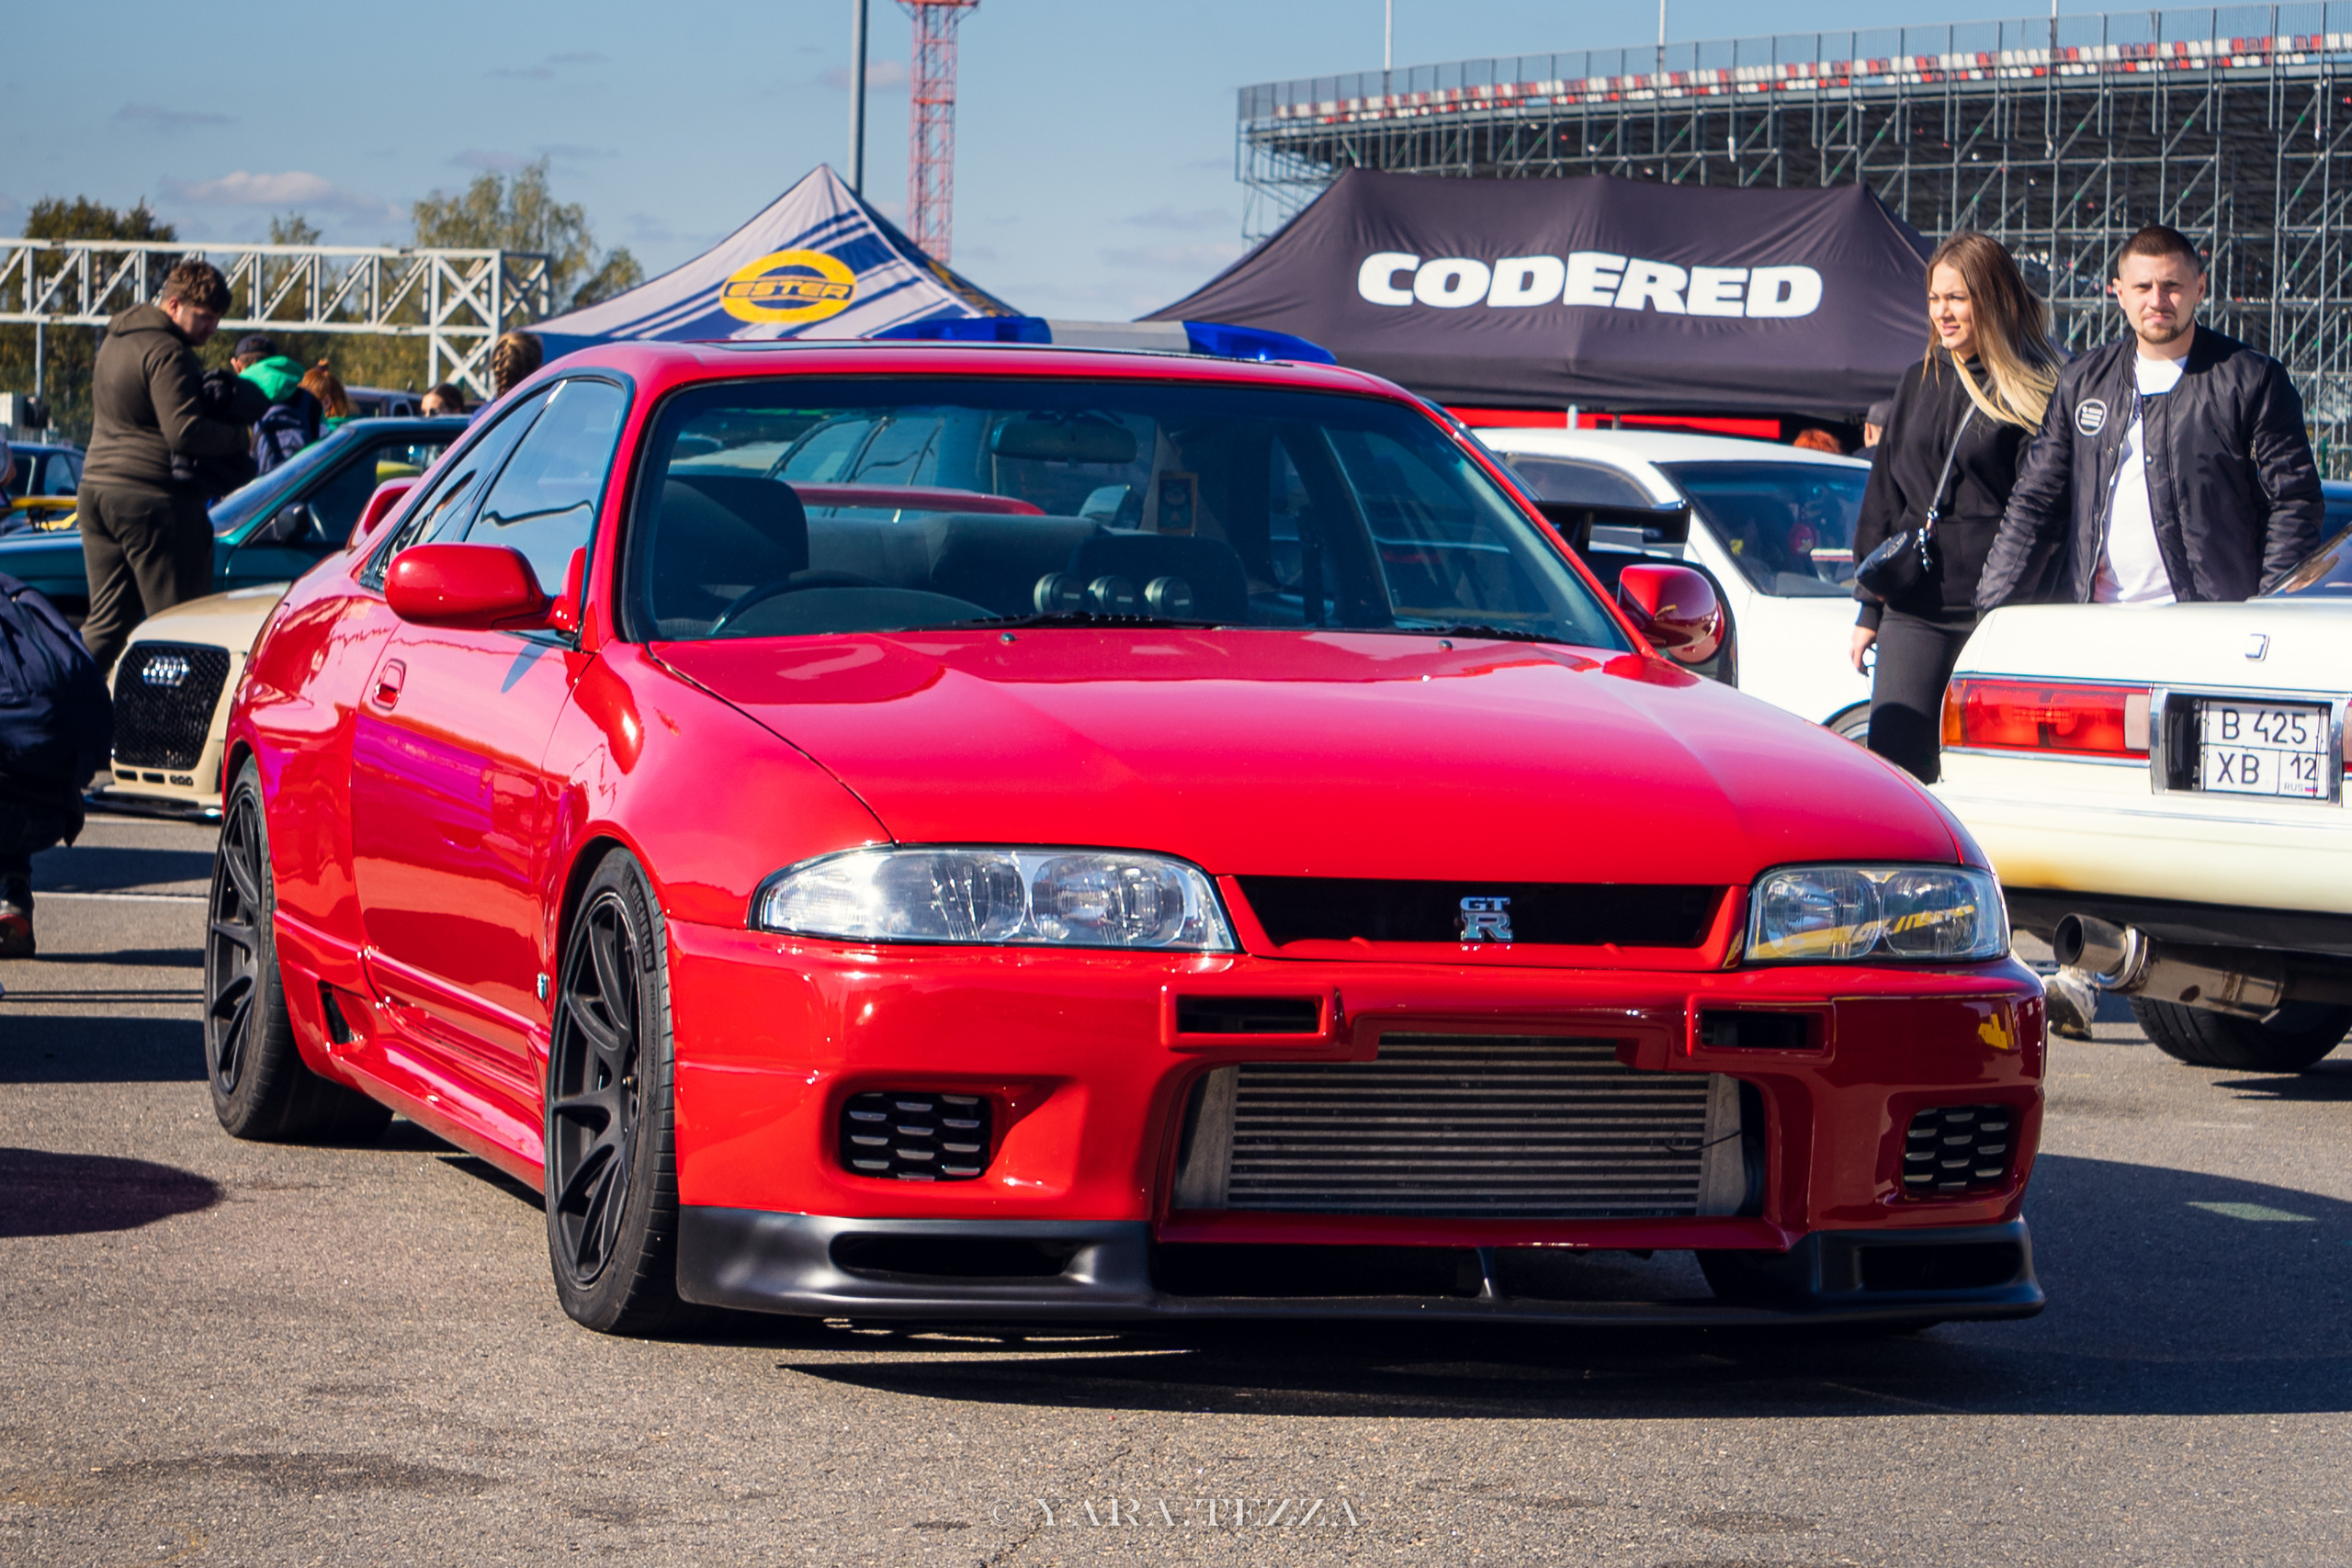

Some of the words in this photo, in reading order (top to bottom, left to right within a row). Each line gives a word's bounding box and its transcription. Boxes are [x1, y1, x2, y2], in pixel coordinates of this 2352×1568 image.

[728, 281, 851, 299] ESTER
[1358, 251, 1823, 318] CODERED
[2253, 710, 2307, 745] 425
[2290, 752, 2316, 781] 12
[2284, 782, 2303, 793] RUS
[1460, 896, 1511, 911] GT
[629, 883, 654, 969] MICHELIN
[1461, 911, 1513, 942] R
